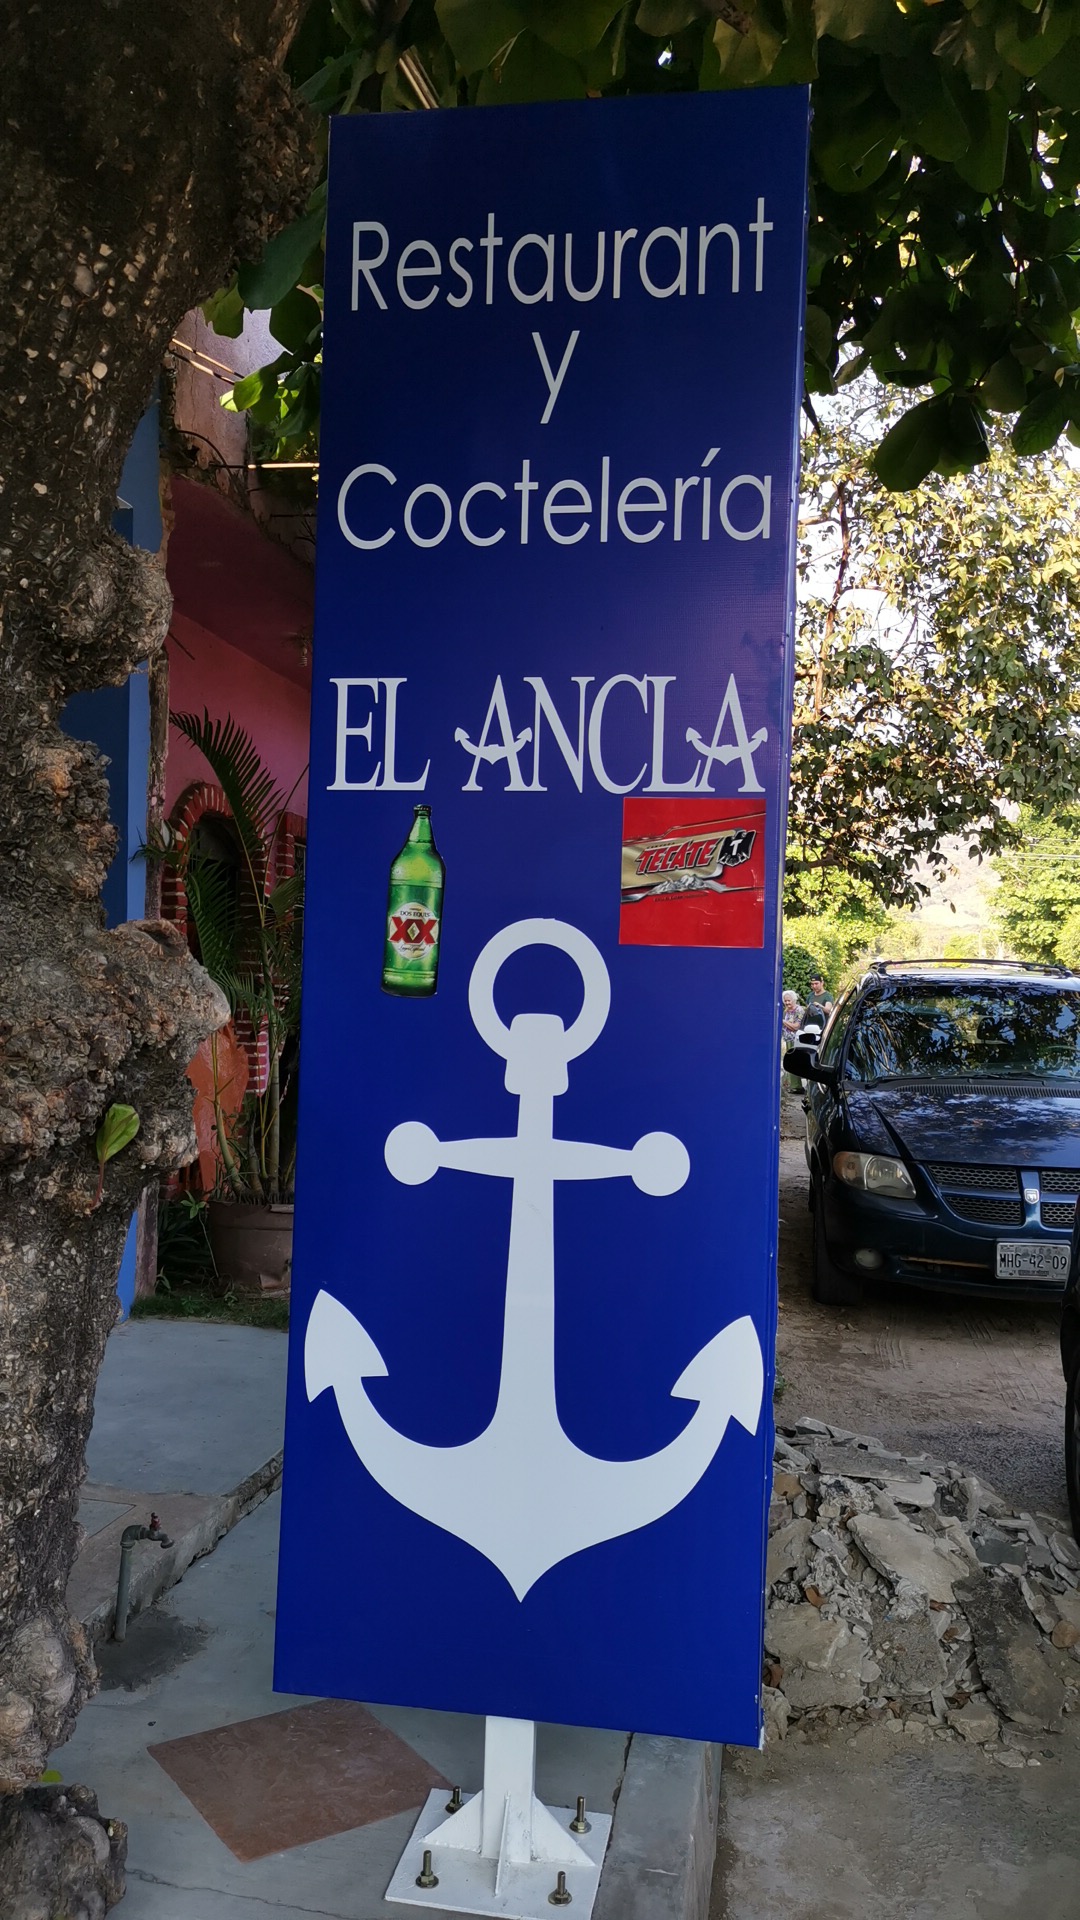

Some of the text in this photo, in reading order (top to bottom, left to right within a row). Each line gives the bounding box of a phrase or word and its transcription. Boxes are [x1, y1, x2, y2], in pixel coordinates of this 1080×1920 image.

[350, 197, 774, 312] Restaurant
[531, 330, 580, 425] y
[336, 446, 772, 551] Coctelería
[326, 673, 769, 795] EL ANCLA
[635, 838, 723, 875] TECATE
[729, 838, 744, 857] T
[389, 915, 438, 945] XX
[999, 1253, 1068, 1270] MHG-42-09
